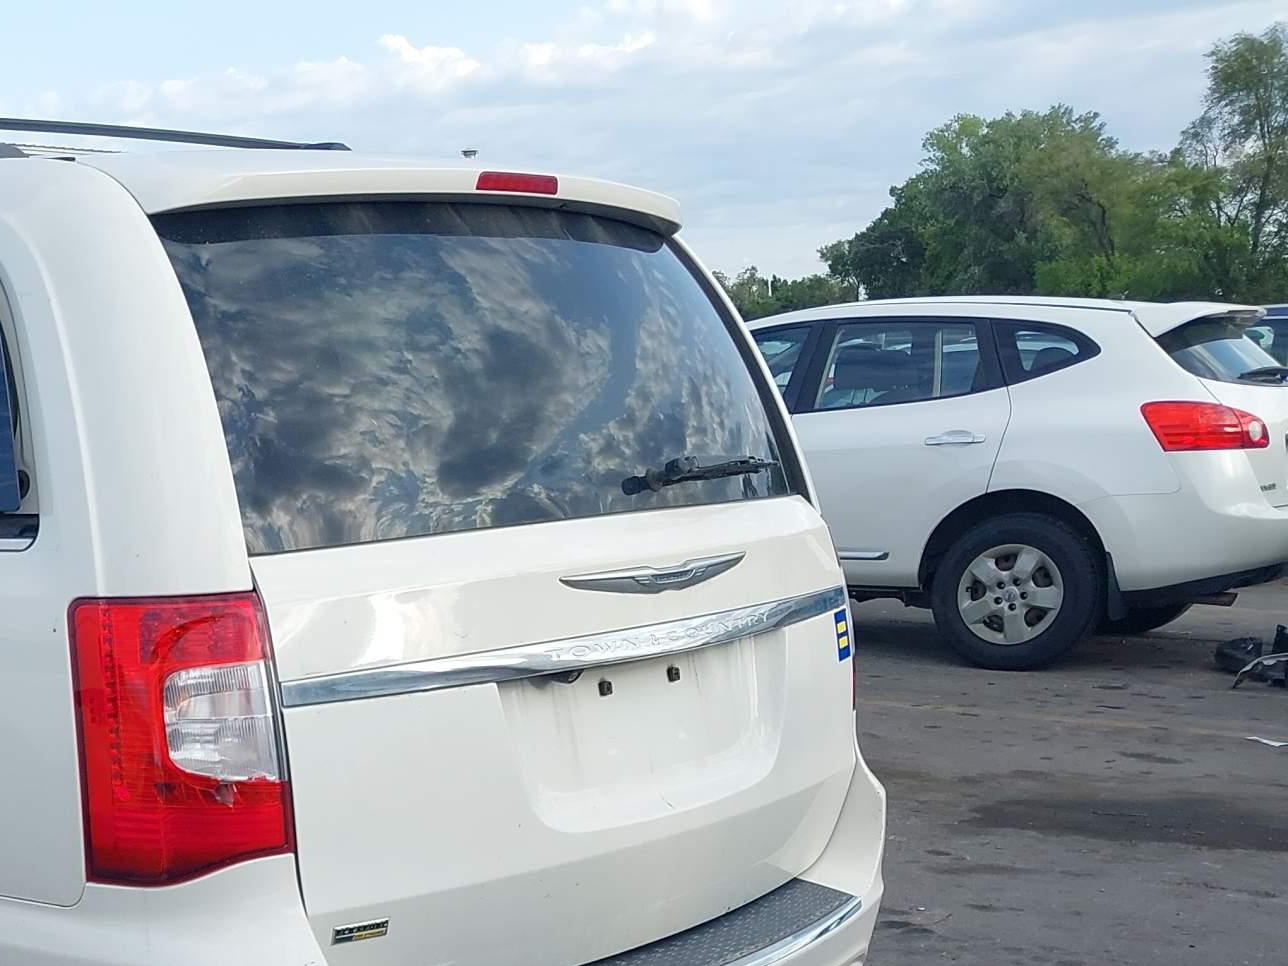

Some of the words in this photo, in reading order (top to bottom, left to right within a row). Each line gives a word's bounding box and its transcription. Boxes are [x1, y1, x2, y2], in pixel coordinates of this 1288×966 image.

[544, 636, 640, 662] TOWN
[649, 633, 661, 647] &
[667, 610, 770, 641] COUNTRY
